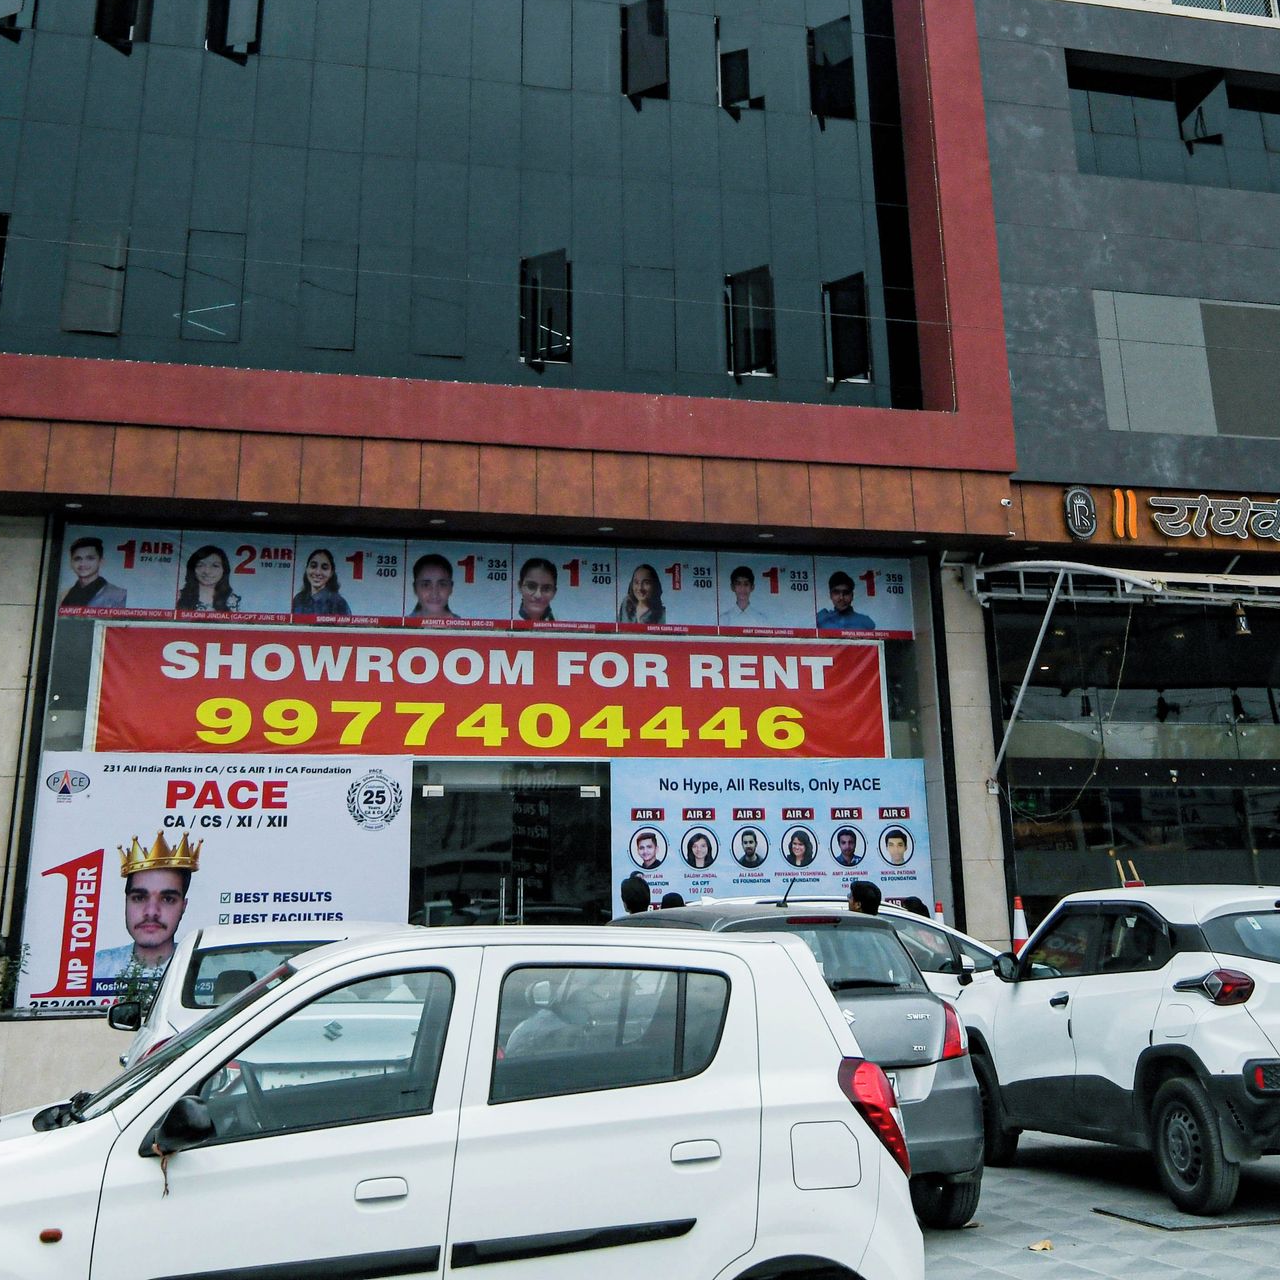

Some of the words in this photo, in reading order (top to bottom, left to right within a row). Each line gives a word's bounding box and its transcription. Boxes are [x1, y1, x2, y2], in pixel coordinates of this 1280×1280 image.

[140, 542, 174, 554] AIR
[235, 545, 257, 574] 2
[260, 548, 293, 561] AIR
[376, 555, 398, 565] 338
[487, 559, 508, 568] 334
[591, 563, 611, 572] 311
[693, 567, 711, 576] 351
[376, 568, 397, 578] 400
[487, 571, 508, 581] 400
[790, 570, 808, 579] 313
[591, 575, 611, 585] 400
[693, 579, 712, 588] 400
[790, 583, 809, 591] 400
[886, 586, 905, 595] 400
[161, 641, 534, 686] SHOWROOM
[557, 651, 670, 688] FOR
[689, 654, 834, 690] RENT
[195, 697, 806, 750] 9977404446
[103, 765, 120, 773] 231
[122, 765, 137, 773] All
[138, 765, 162, 773] India
[164, 765, 193, 773] Ranks
[205, 766, 219, 774] CA
[226, 766, 238, 774] CS
[239, 766, 246, 774] &
[248, 766, 265, 774] AIR
[274, 766, 283, 774] in
[285, 766, 299, 774] CA
[301, 766, 352, 775] Foundation
[659, 778, 678, 791] No
[683, 778, 722, 794] Hype,
[726, 778, 744, 791] All
[749, 778, 804, 794] Results,
[808, 778, 839, 794] Only
[844, 778, 881, 791] PACE
[165, 780, 288, 810] PACE
[363, 790, 386, 805] 25
[636, 811, 654, 819] AIR
[655, 811, 661, 819] 1
[686, 810, 704, 818] AIR
[706, 810, 712, 818] 2
[736, 810, 754, 818] AIR
[756, 810, 762, 818] 3
[786, 810, 803, 818] AIR
[804, 810, 810, 818] 4
[834, 809, 852, 818] AIR
[853, 809, 859, 818] 5
[882, 809, 900, 817] AIR
[900, 809, 906, 817] 6
[163, 815, 185, 827] CA
[200, 815, 222, 827] CS
[236, 815, 252, 827] XI
[266, 815, 288, 827] XII
[234, 893, 269, 903] BEST
[273, 891, 333, 903] RESULTS
[70, 866, 98, 952] TOPPER
[233, 913, 268, 925] BEST
[272, 912, 344, 923] FACULTIES
[66, 958, 89, 990] MP
[907, 1013, 931, 1021] SWIFT
